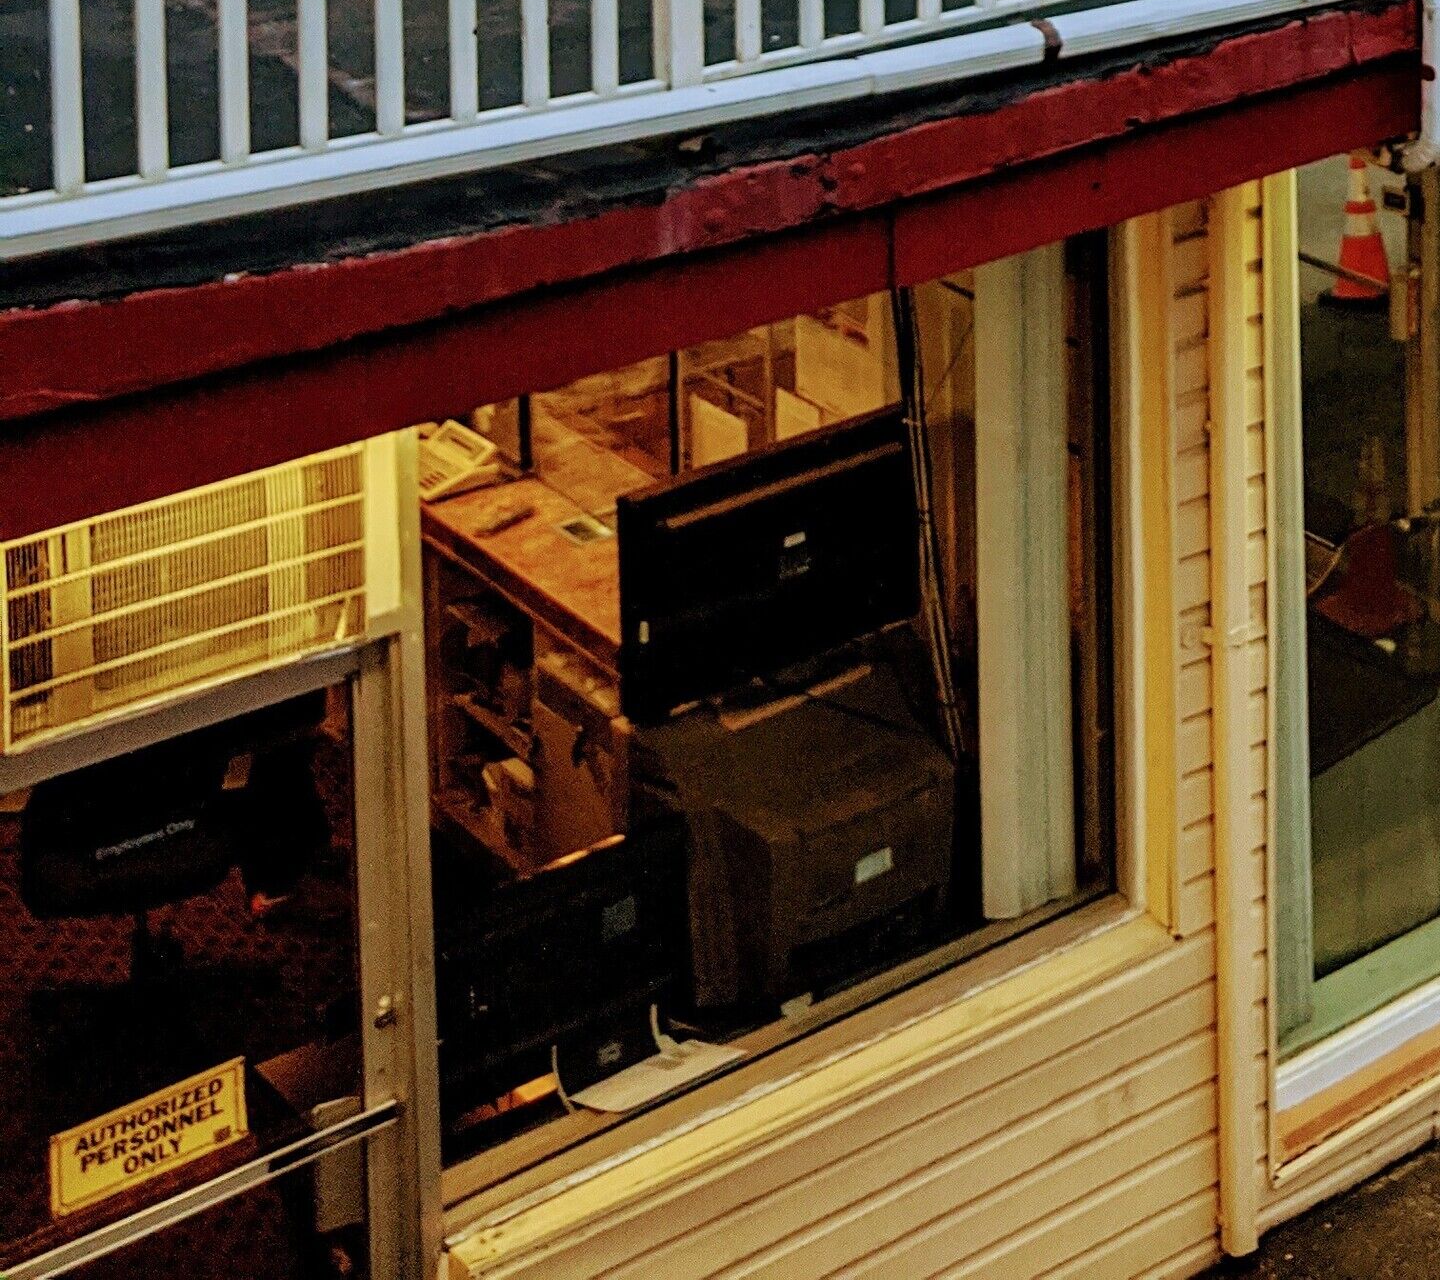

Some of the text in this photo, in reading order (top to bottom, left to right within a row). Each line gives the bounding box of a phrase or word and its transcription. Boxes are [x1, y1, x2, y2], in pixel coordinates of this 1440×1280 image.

[75, 1078, 222, 1154] AUTHORIZED
[81, 1100, 224, 1173] PERSONNEL
[123, 1135, 182, 1174] ONLY
